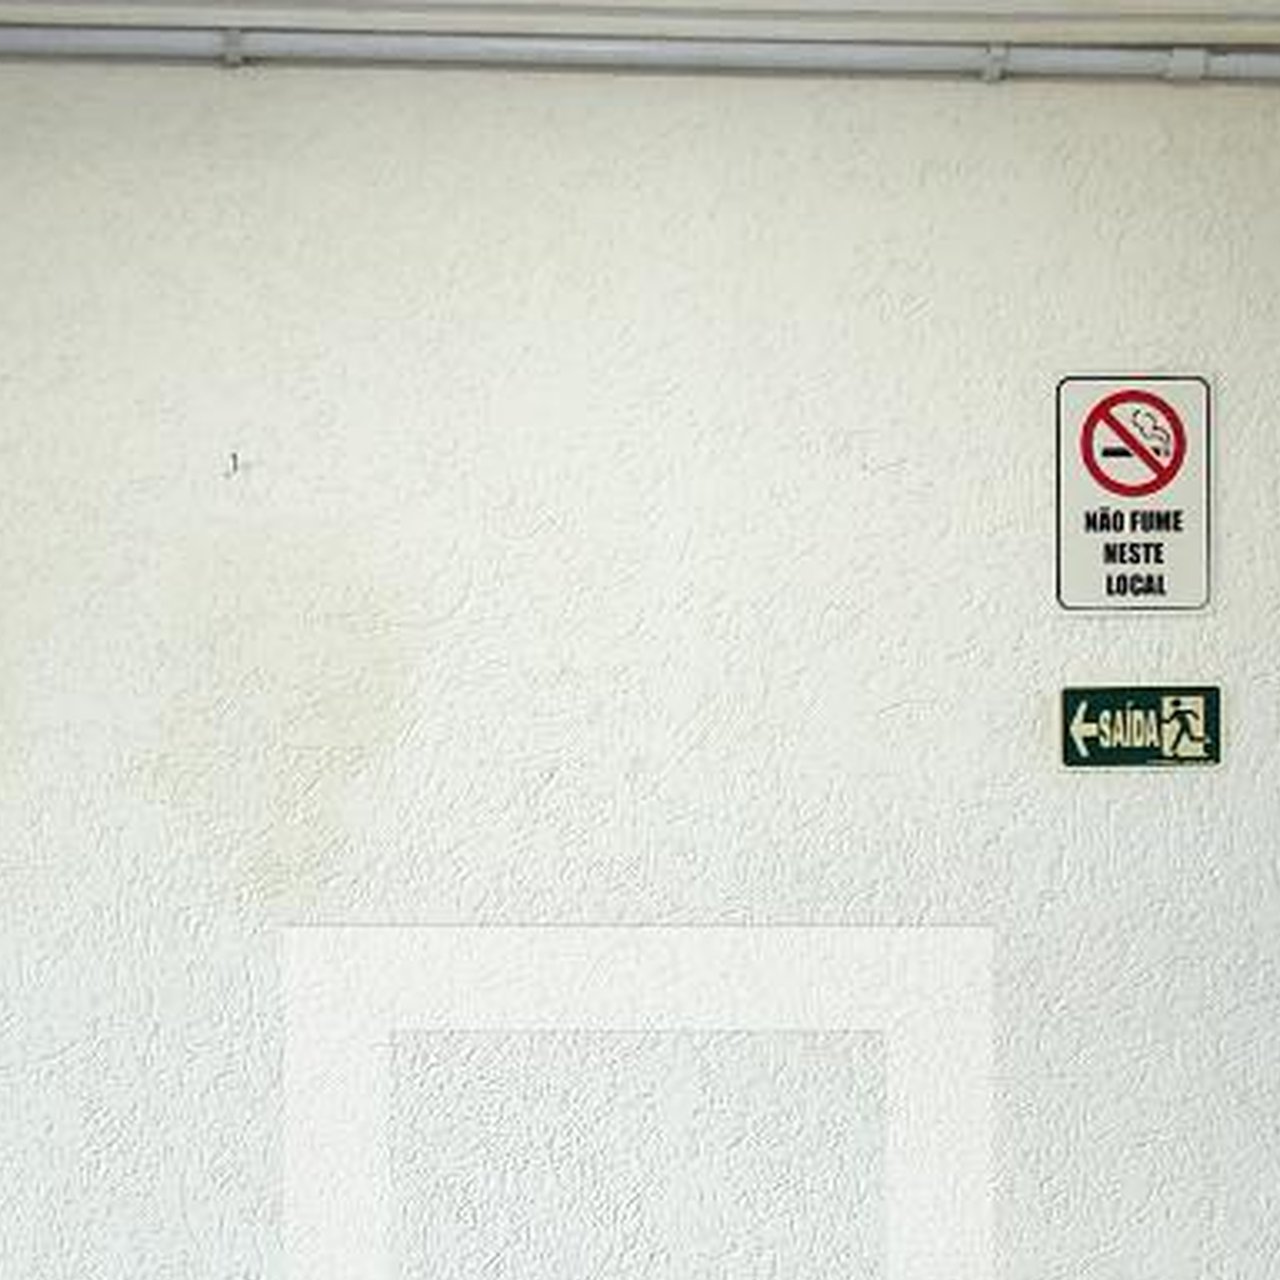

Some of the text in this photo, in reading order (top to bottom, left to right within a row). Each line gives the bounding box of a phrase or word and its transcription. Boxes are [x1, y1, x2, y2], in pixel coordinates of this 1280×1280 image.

[1084, 506, 1184, 533] NÃO FUME
[1103, 542, 1165, 565] NESTE
[1106, 573, 1167, 597] LOCAL
[1098, 700, 1161, 748] SAÍDA
